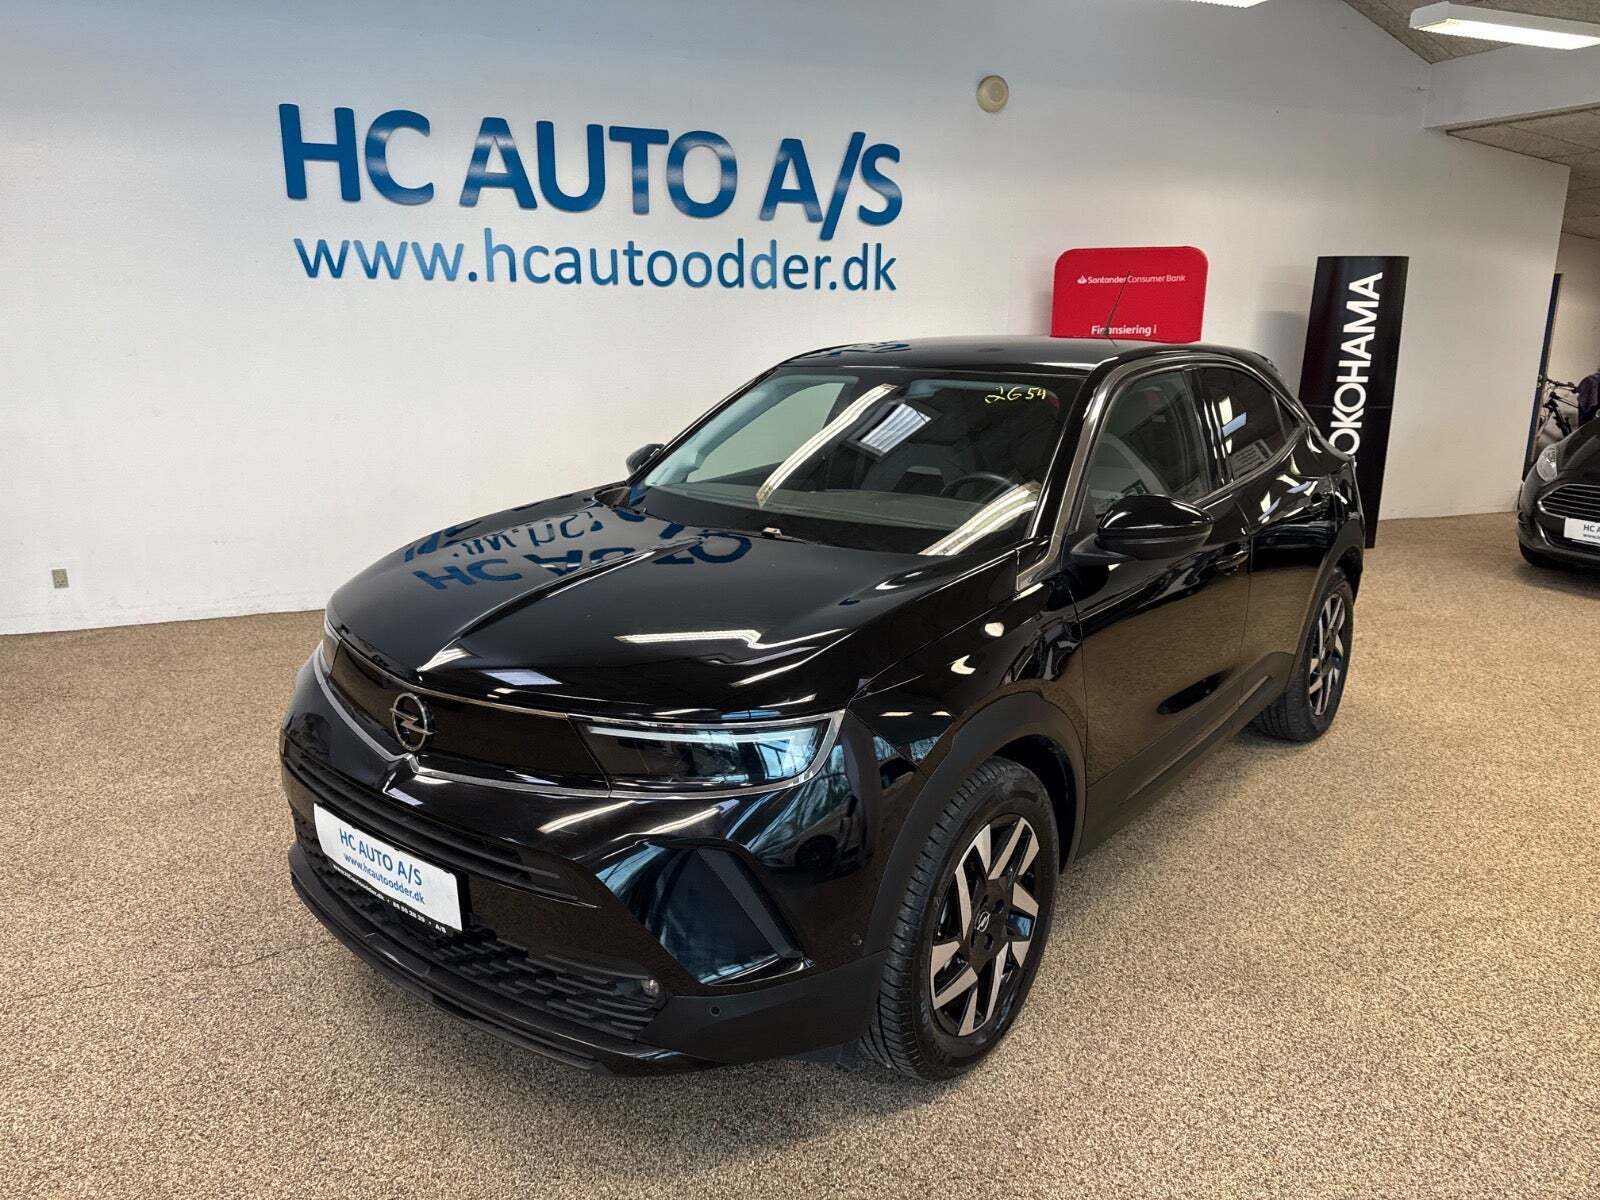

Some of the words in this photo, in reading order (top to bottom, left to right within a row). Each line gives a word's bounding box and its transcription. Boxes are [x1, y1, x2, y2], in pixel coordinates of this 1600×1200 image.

[278, 103, 434, 206] HC
[459, 117, 738, 219] AUTO
[759, 131, 903, 241] A/S
[293, 228, 898, 291] www.hcautoodder.dk
[1087, 275, 1126, 284] Santander
[1127, 275, 1166, 284] Consumer
[1166, 274, 1186, 282] Bank
[1328, 271, 1384, 467] OKOHAMA
[339, 827, 357, 851] HC
[358, 840, 394, 872] AUTO
[397, 860, 423, 886] A/S
